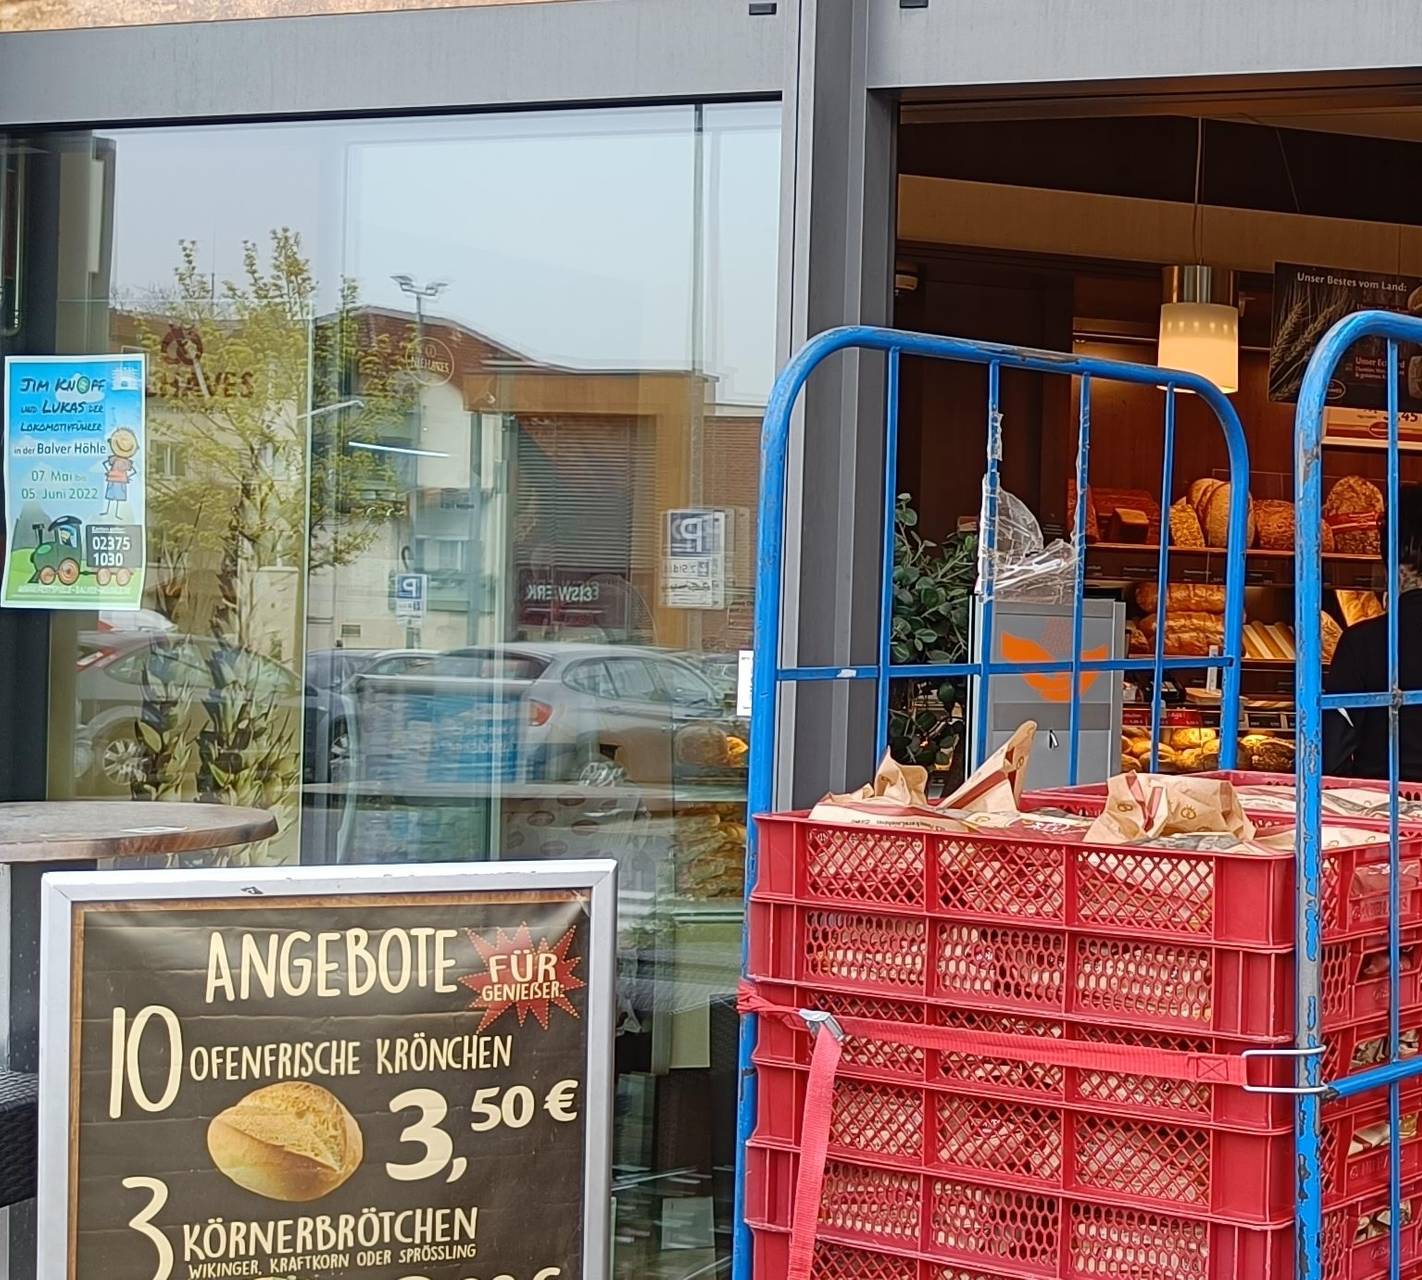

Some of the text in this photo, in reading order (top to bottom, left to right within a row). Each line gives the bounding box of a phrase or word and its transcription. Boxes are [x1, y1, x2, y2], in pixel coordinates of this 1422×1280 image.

[1297, 272, 1407, 292] Unser Bestes vom Land:
[20, 377, 49, 392] JIM
[42, 400, 88, 414] LUKAS
[37, 442, 71, 454] Balver
[74, 442, 106, 454] Höhle
[51, 471, 72, 480] Mai
[42, 488, 66, 499] Juni
[68, 488, 98, 499] 2022
[92, 537, 131, 551] 02375
[94, 553, 124, 566] 1030
[205, 928, 458, 1003] ANGEBOTE
[488, 949, 558, 983] FÜR
[109, 1005, 183, 1119] 10
[190, 1032, 513, 1081] OFENFRISCHE KRÖNCHEN
[544, 1080, 579, 1122] €
[122, 1176, 174, 1280] 3
[183, 1207, 478, 1262] KÖRNERBRÖTCHEN
[270, 1253, 349, 1275] KRAFTKORN
[357, 1251, 392, 1268] ODER
[399, 1243, 477, 1264] SPRÖSSLING
